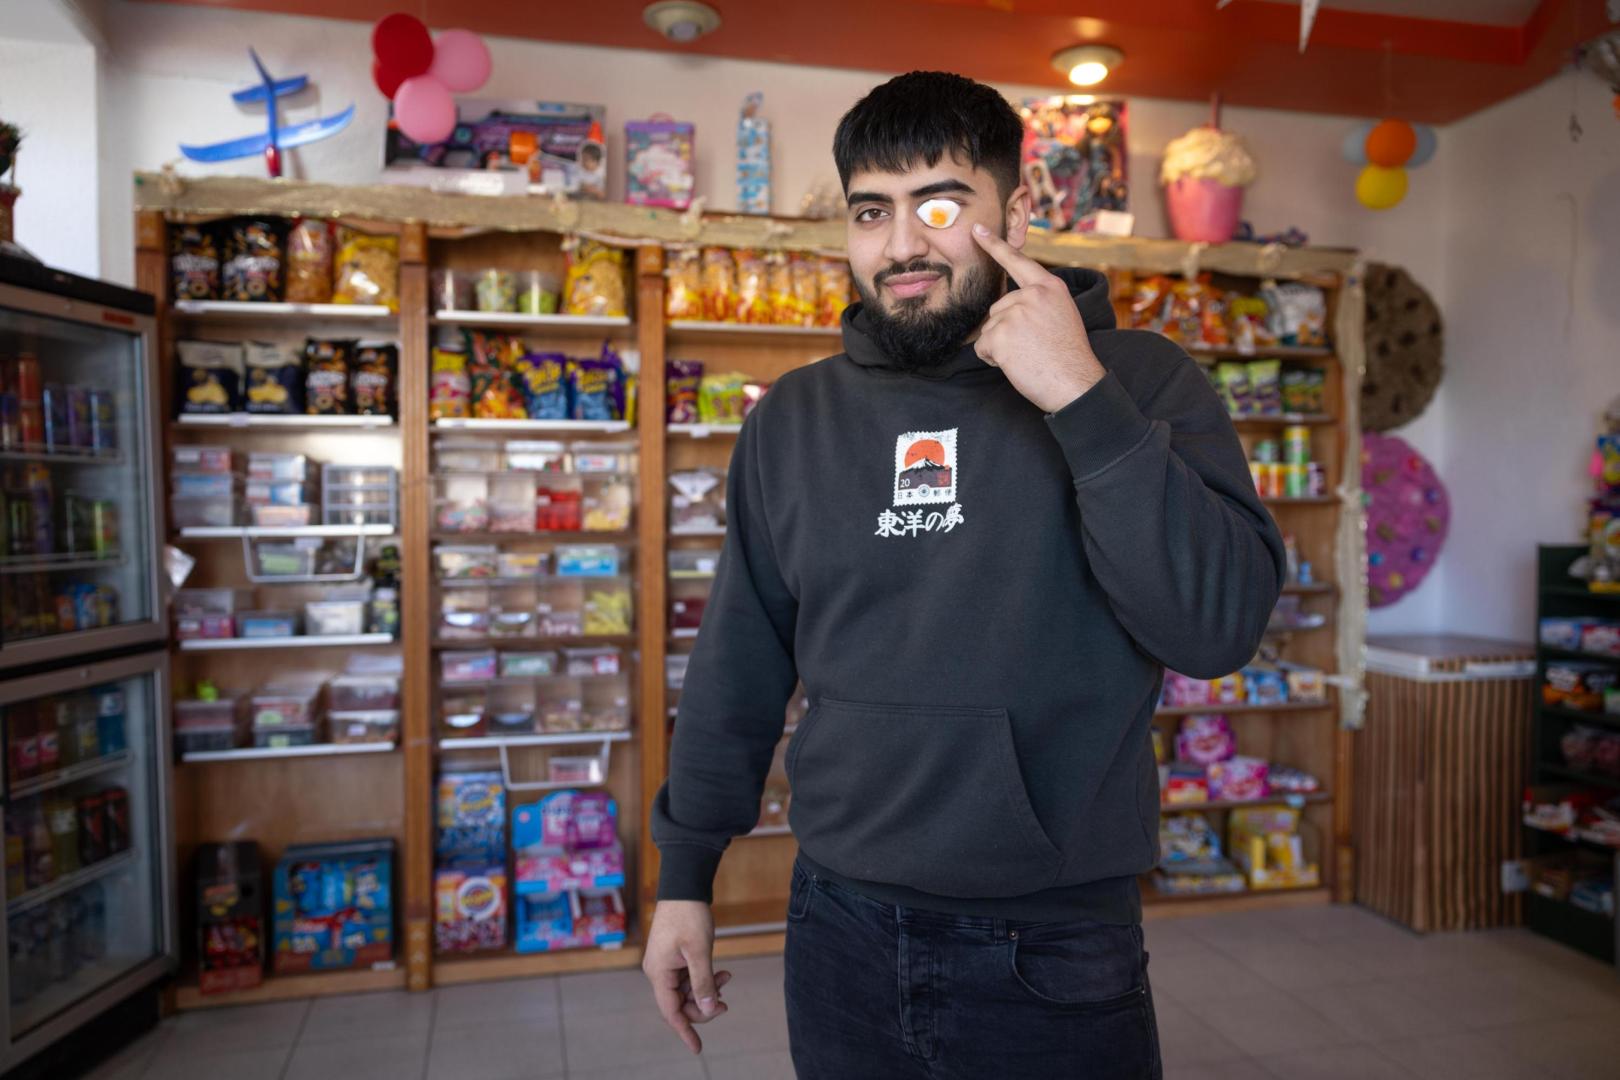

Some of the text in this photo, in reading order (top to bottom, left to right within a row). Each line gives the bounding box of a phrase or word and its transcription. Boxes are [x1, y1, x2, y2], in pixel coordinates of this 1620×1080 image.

[900, 478, 911, 488] 20
[874, 503, 964, 538] 東洋の夢
